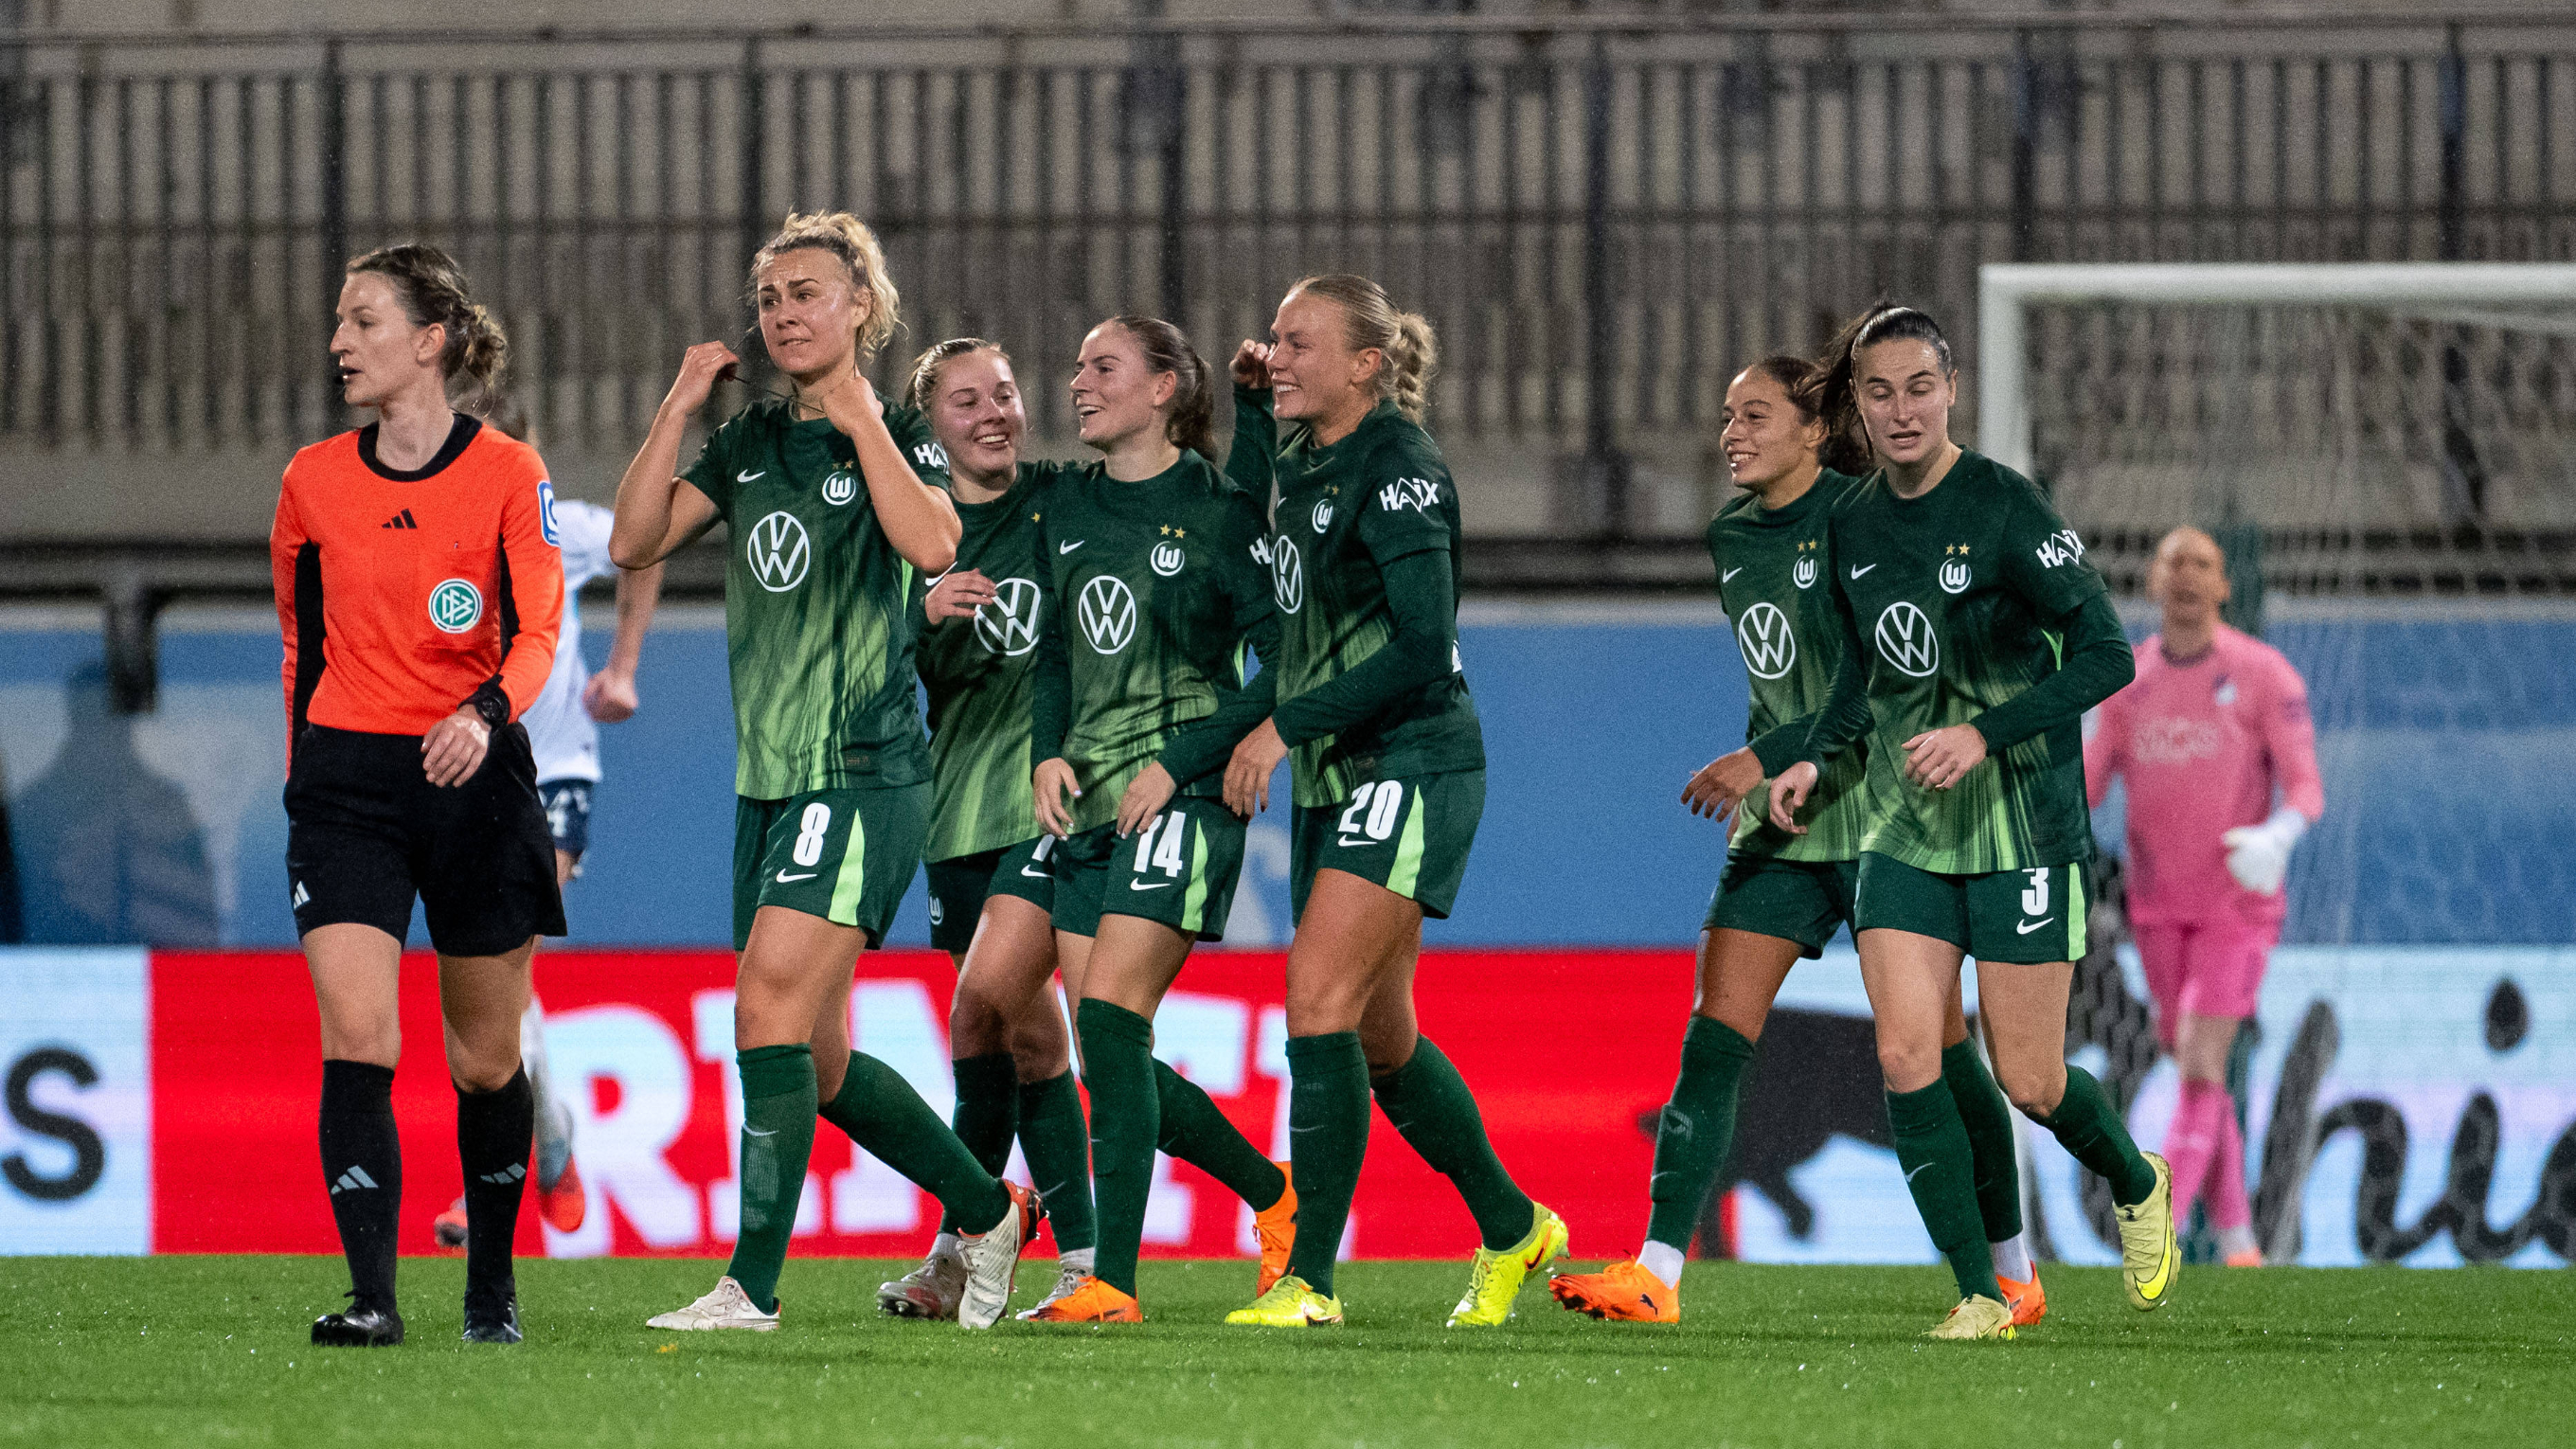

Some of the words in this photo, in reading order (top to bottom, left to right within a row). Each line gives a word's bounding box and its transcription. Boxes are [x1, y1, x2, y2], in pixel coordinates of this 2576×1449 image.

[794, 802, 832, 867] 8
[1337, 779, 1403, 841] 20
[1134, 811, 1187, 878] 14
[2022, 867, 2049, 916] 3
